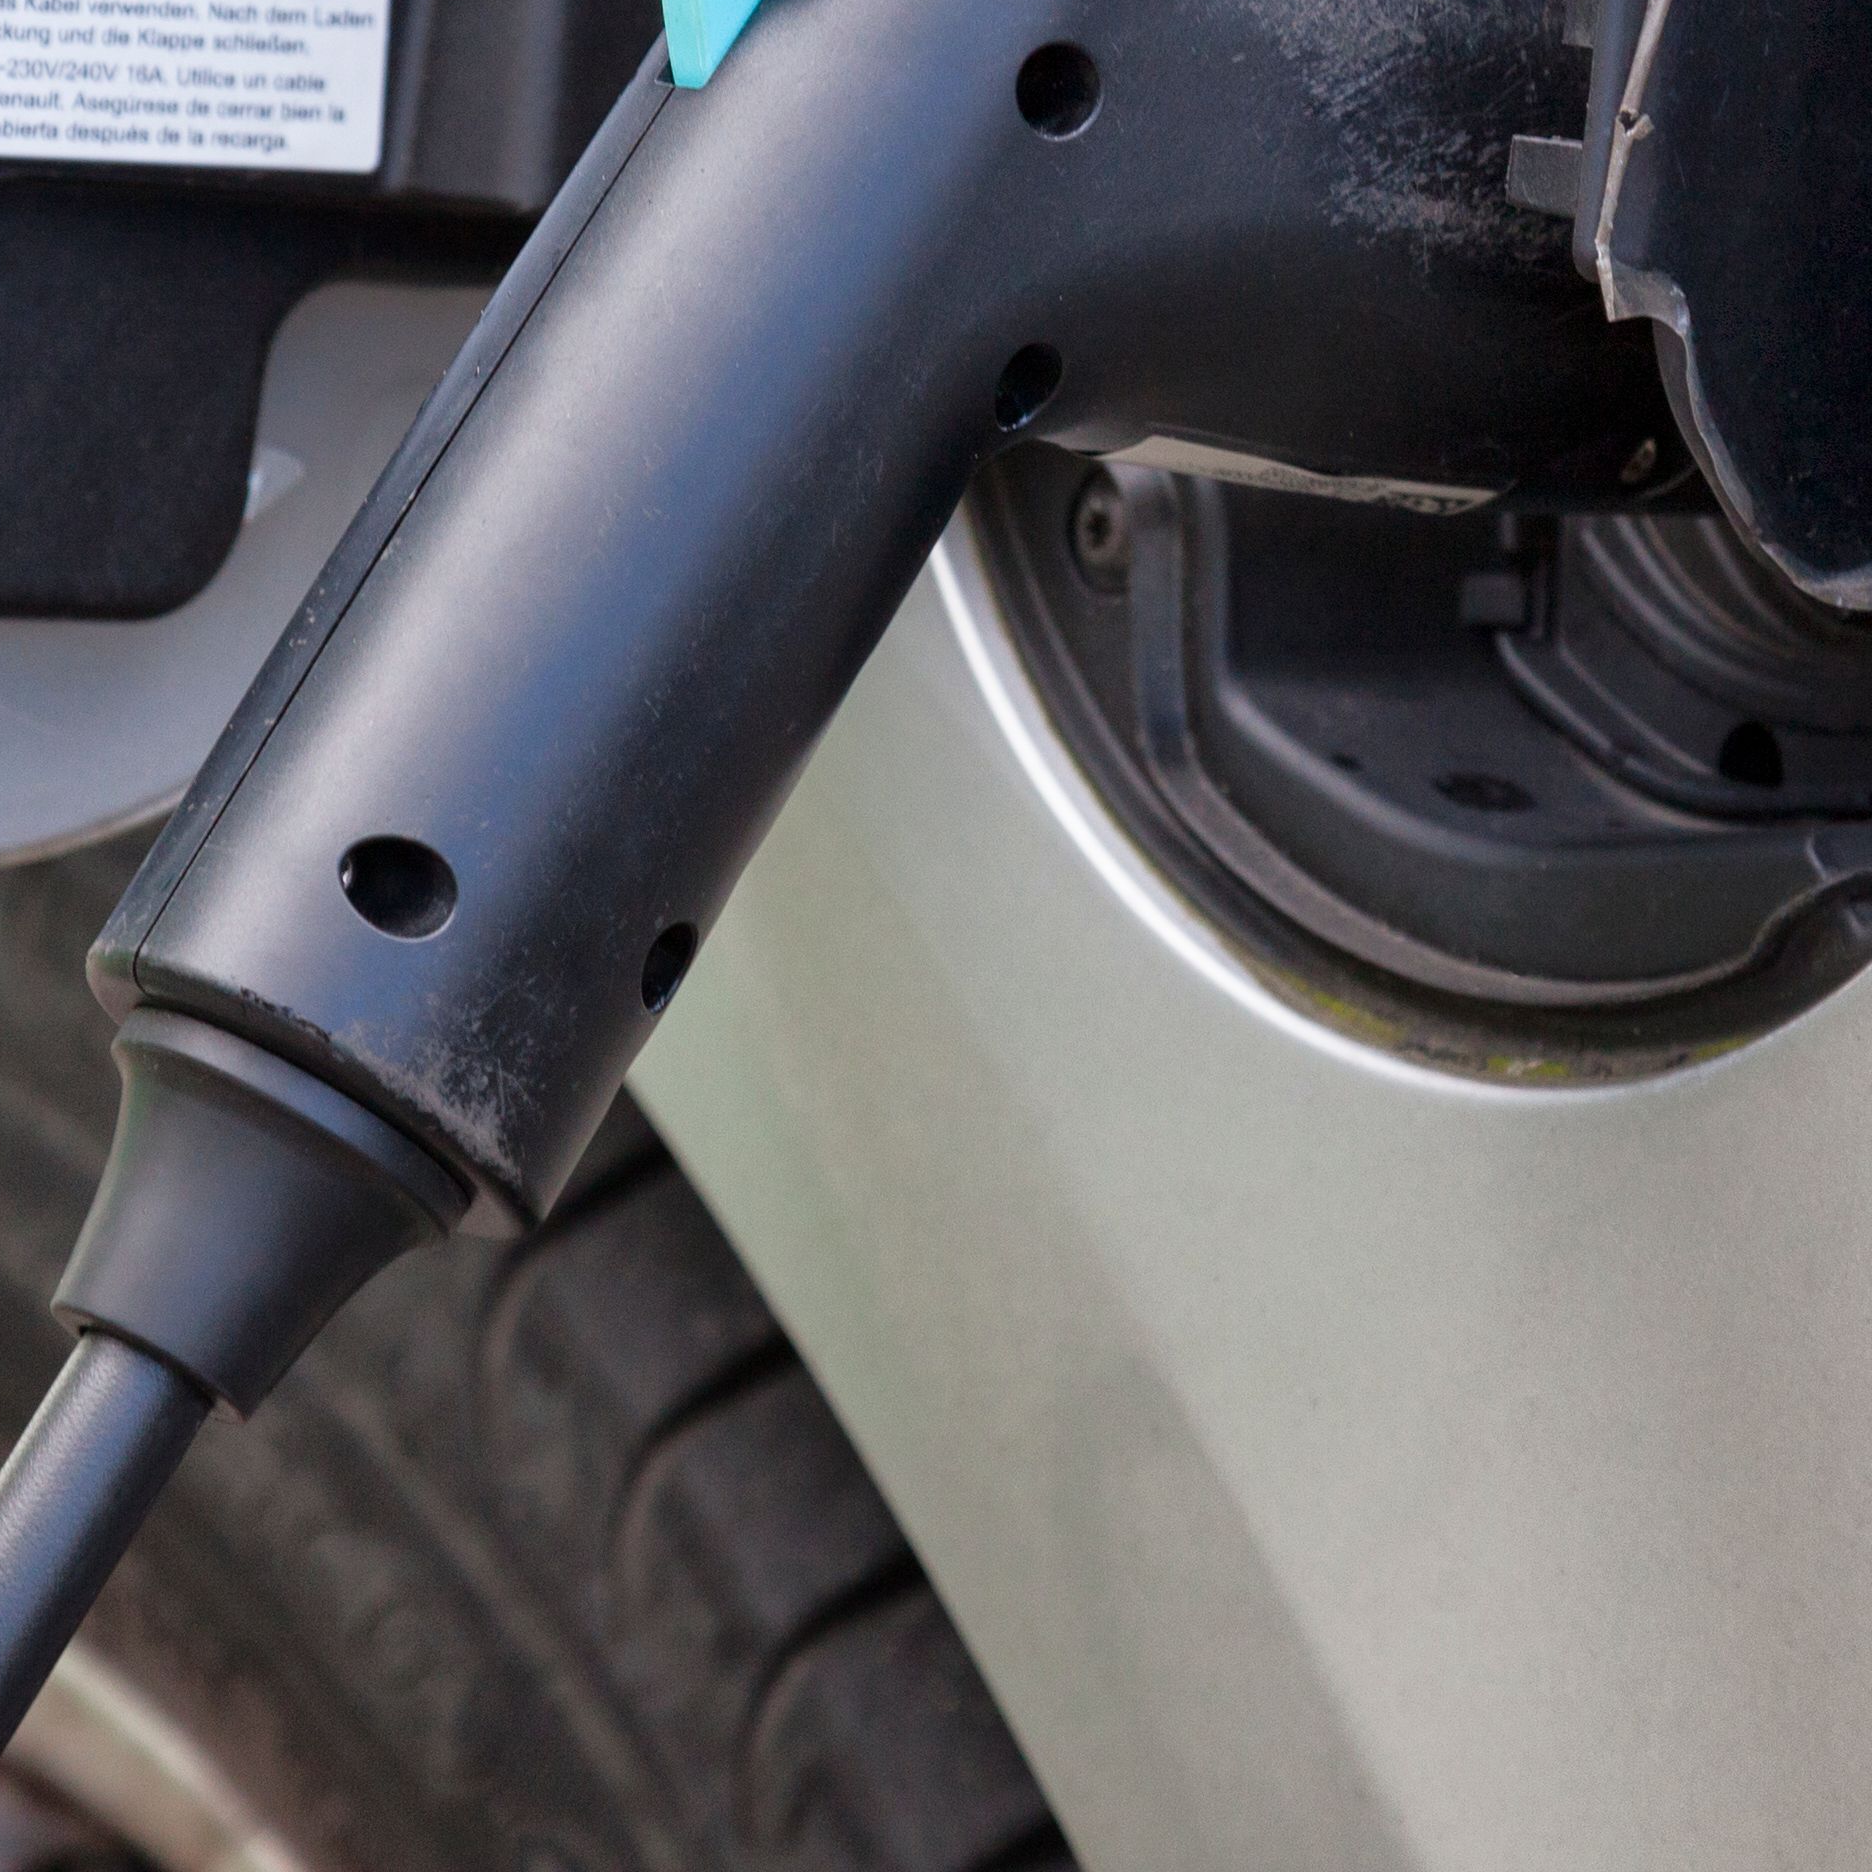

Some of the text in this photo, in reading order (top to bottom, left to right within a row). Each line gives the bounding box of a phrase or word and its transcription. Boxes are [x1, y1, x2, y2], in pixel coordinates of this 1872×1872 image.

[208, 2, 258, 22] Nach
[264, 6, 307, 24] dem
[313, 8, 374, 28] Laden
[57, 26, 95, 44] und
[101, 27, 131, 46] die
[137, 28, 206, 51] Klappe
[176, 67, 236, 88] Utilice
[242, 73, 267, 89] un
[273, 73, 326, 92] cable
[185, 98, 210, 117] de
[216, 103, 274, 120] cerrar
[280, 103, 322, 121] bien
[328, 105, 346, 123] la
[156, 125, 181, 145] de
[187, 128, 205, 147] la
